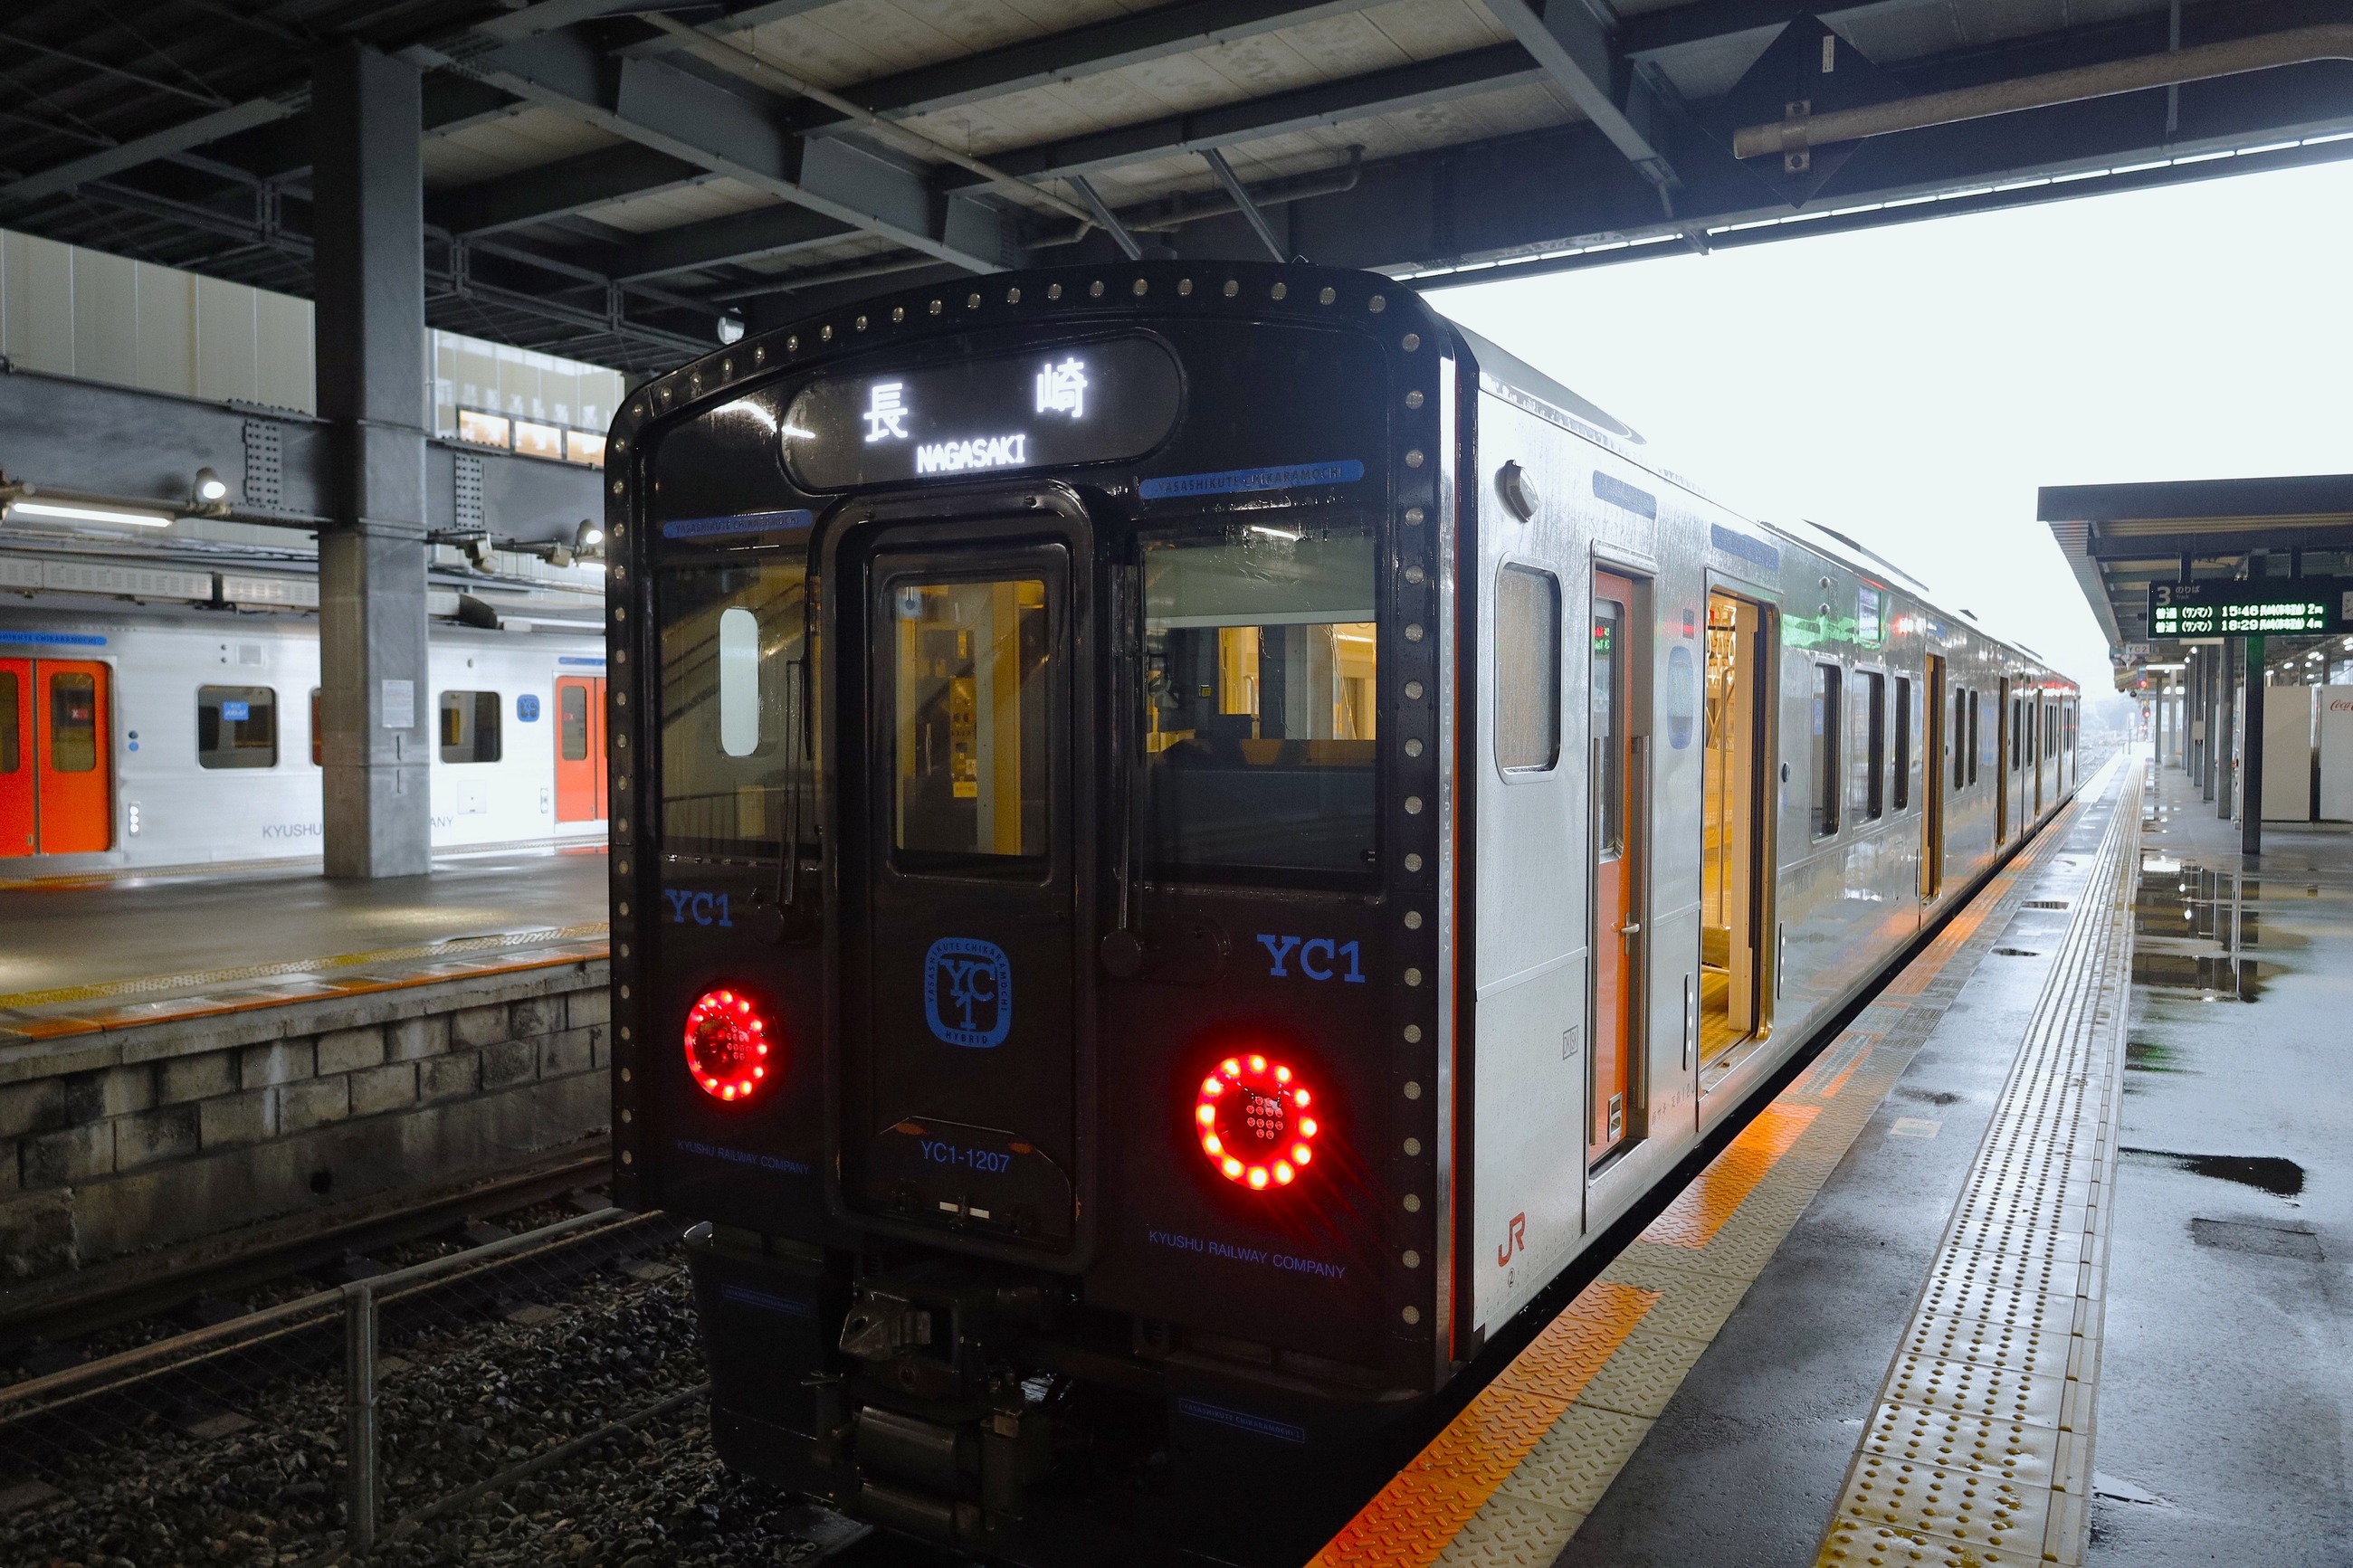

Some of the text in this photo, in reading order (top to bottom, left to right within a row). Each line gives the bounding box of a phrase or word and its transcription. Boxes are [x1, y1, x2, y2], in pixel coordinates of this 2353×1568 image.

[917, 434, 1025, 473] NAGASAKI
[1158, 466, 1343, 493] YASASHIKUTE CHIKARAMOCHI
[2157, 585, 2171, 606] 3
[2176, 585, 2200, 594] のりば
[2222, 604, 2259, 617] 15:46
[262, 823, 322, 839] KYUSHU
[665, 889, 733, 927] YC1
[1256, 934, 1366, 984] YC1
[965, 943, 1008, 1012] CHIKARAMOCHI
[946, 1031, 988, 1044] HYBRID
[677, 1139, 810, 1174] KYUSHU RAILWAY COMPANY
[921, 1141, 1010, 1173] YC1-1207
[1148, 1231, 1346, 1278] KYUSHU RAILWAY COMPANY
[1499, 1212, 1526, 1268] JR
[1184, 1402, 1234, 1421] YASASHIKUTE
[1235, 1416, 1294, 1437] CHIKARAMOCHI
